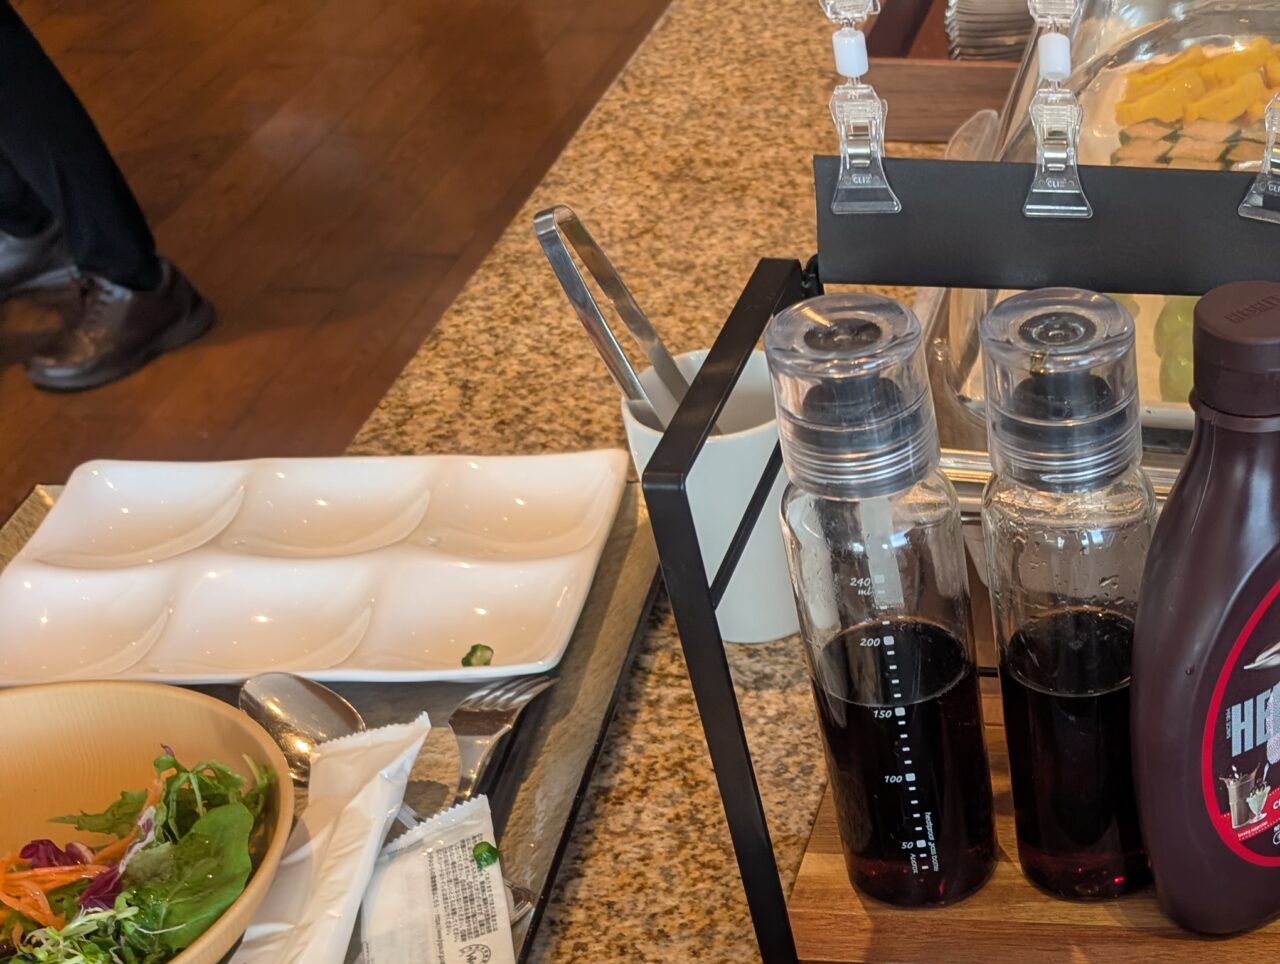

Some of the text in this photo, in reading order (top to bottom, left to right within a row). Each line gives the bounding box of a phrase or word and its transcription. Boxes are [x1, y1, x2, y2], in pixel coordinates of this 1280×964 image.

[850, 577, 871, 587] 240
[860, 638, 881, 647] 200
[873, 709, 893, 719] 150
[884, 774, 903, 784] 100
[901, 840, 914, 849] 50
